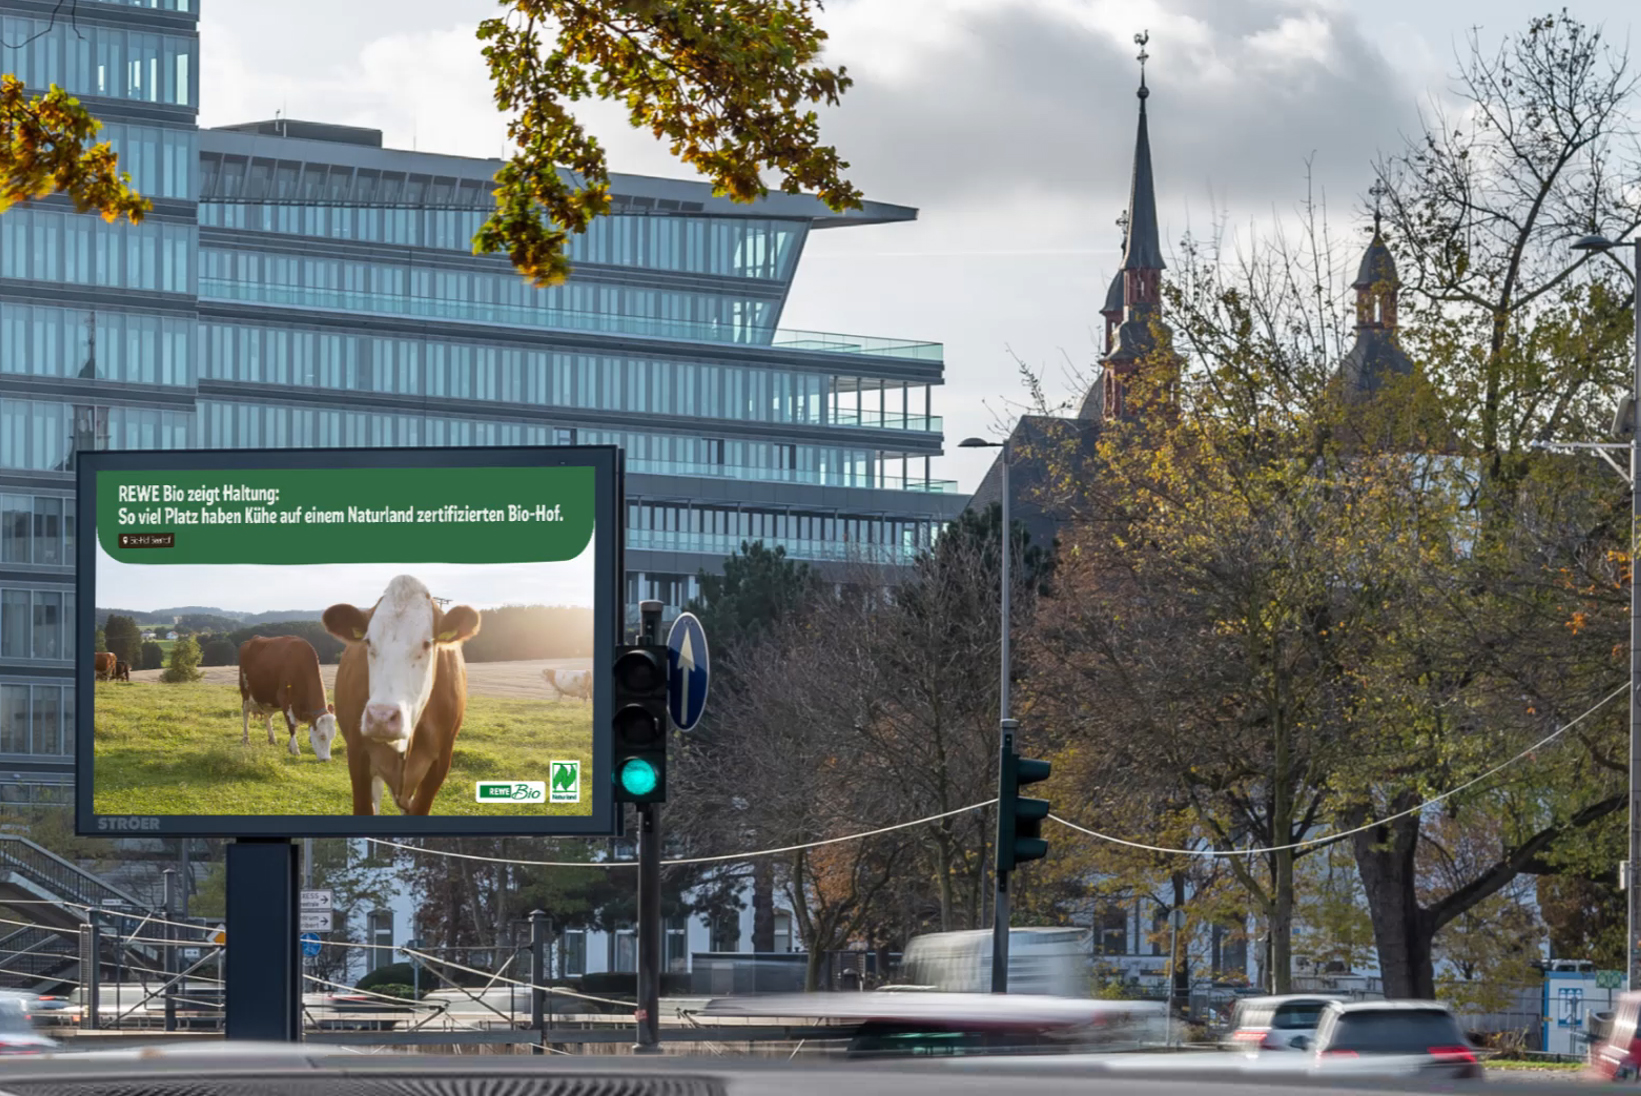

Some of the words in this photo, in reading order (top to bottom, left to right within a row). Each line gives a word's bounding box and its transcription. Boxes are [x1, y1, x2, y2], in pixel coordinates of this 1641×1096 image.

[118, 485, 160, 502] REWE
[163, 485, 184, 502] Bio
[187, 485, 220, 506] zeigt
[222, 484, 280, 505] Haltung:
[118, 508, 136, 525] So
[138, 508, 161, 525] viel
[165, 508, 199, 525] Platz
[201, 507, 242, 525] haben
[245, 507, 277, 524] Kühe
[280, 506, 302, 524] auf
[304, 506, 345, 523] einem
[348, 505, 414, 523] Naturland
[416, 505, 505, 522] zertifizierten
[508, 504, 564, 521] Bio-Hof.
[512, 784, 541, 800] Bio
[98, 816, 161, 830] STRÖER
